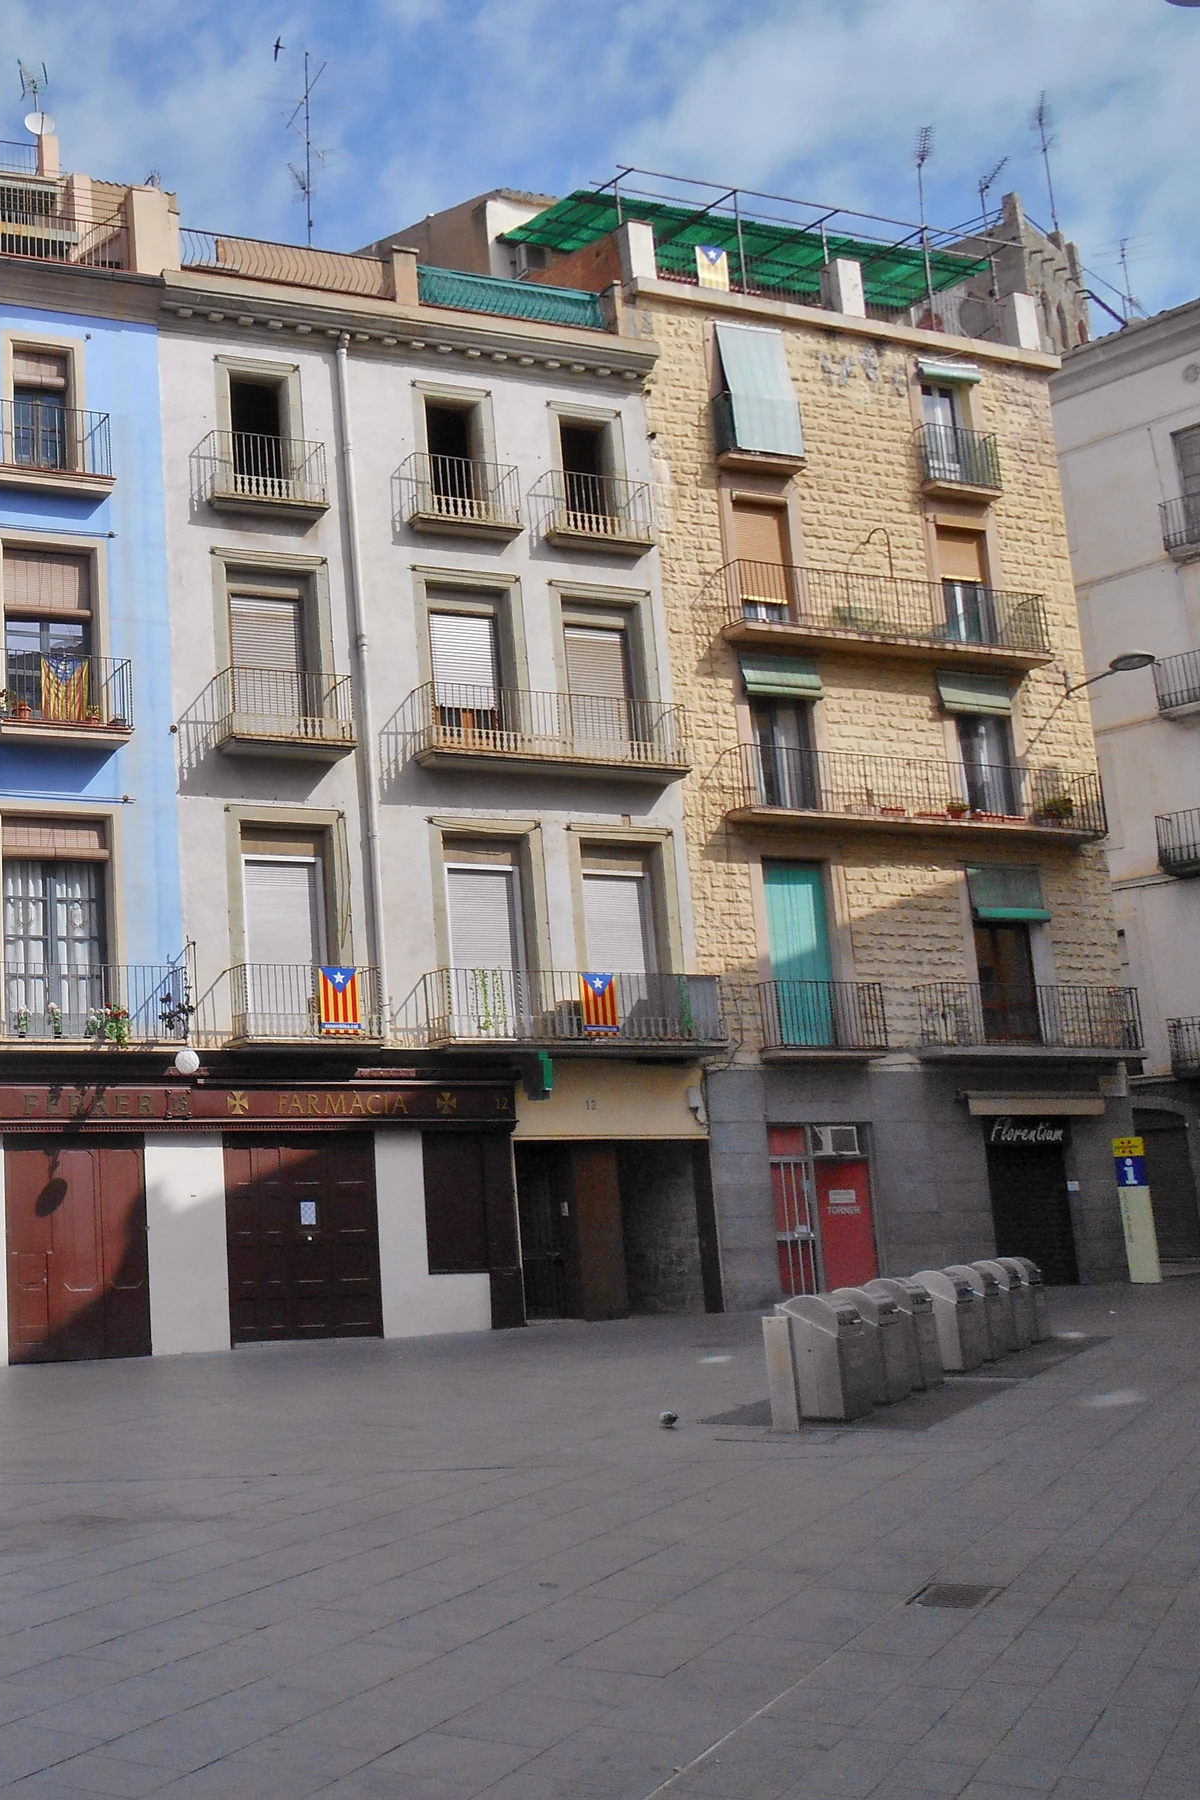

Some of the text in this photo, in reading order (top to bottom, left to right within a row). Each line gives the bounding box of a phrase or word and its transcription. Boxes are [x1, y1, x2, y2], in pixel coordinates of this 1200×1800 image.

[23, 1093, 154, 1117] FERRER
[277, 1090, 409, 1115] FARMÀCIA
[496, 1097, 509, 1110] 12
[586, 1099, 597, 1110] 12
[826, 1206, 861, 1215] TORNER
